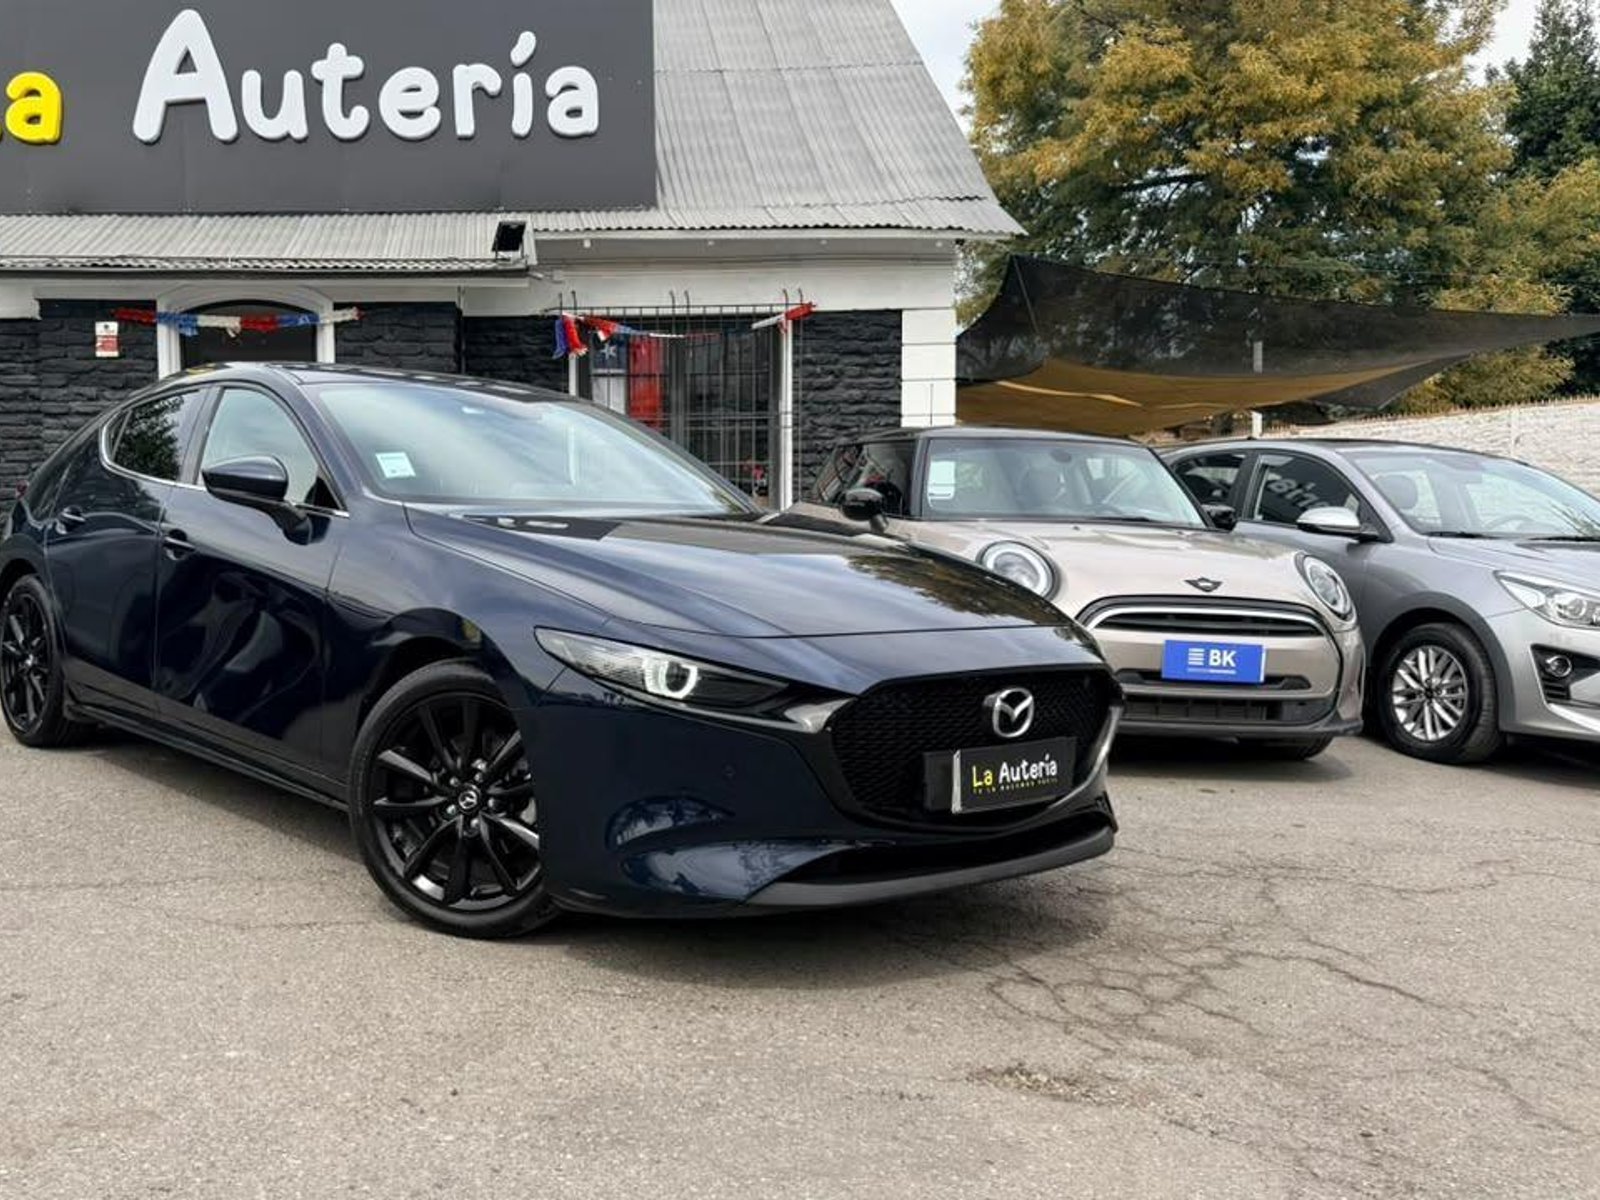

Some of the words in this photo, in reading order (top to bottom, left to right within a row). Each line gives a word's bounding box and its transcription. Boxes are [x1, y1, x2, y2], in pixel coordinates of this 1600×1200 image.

[0, 71, 62, 143] a
[133, 9, 600, 142] Autería
[1209, 649, 1237, 667] BK
[972, 765, 993, 787] La
[998, 753, 1058, 784] Autería
